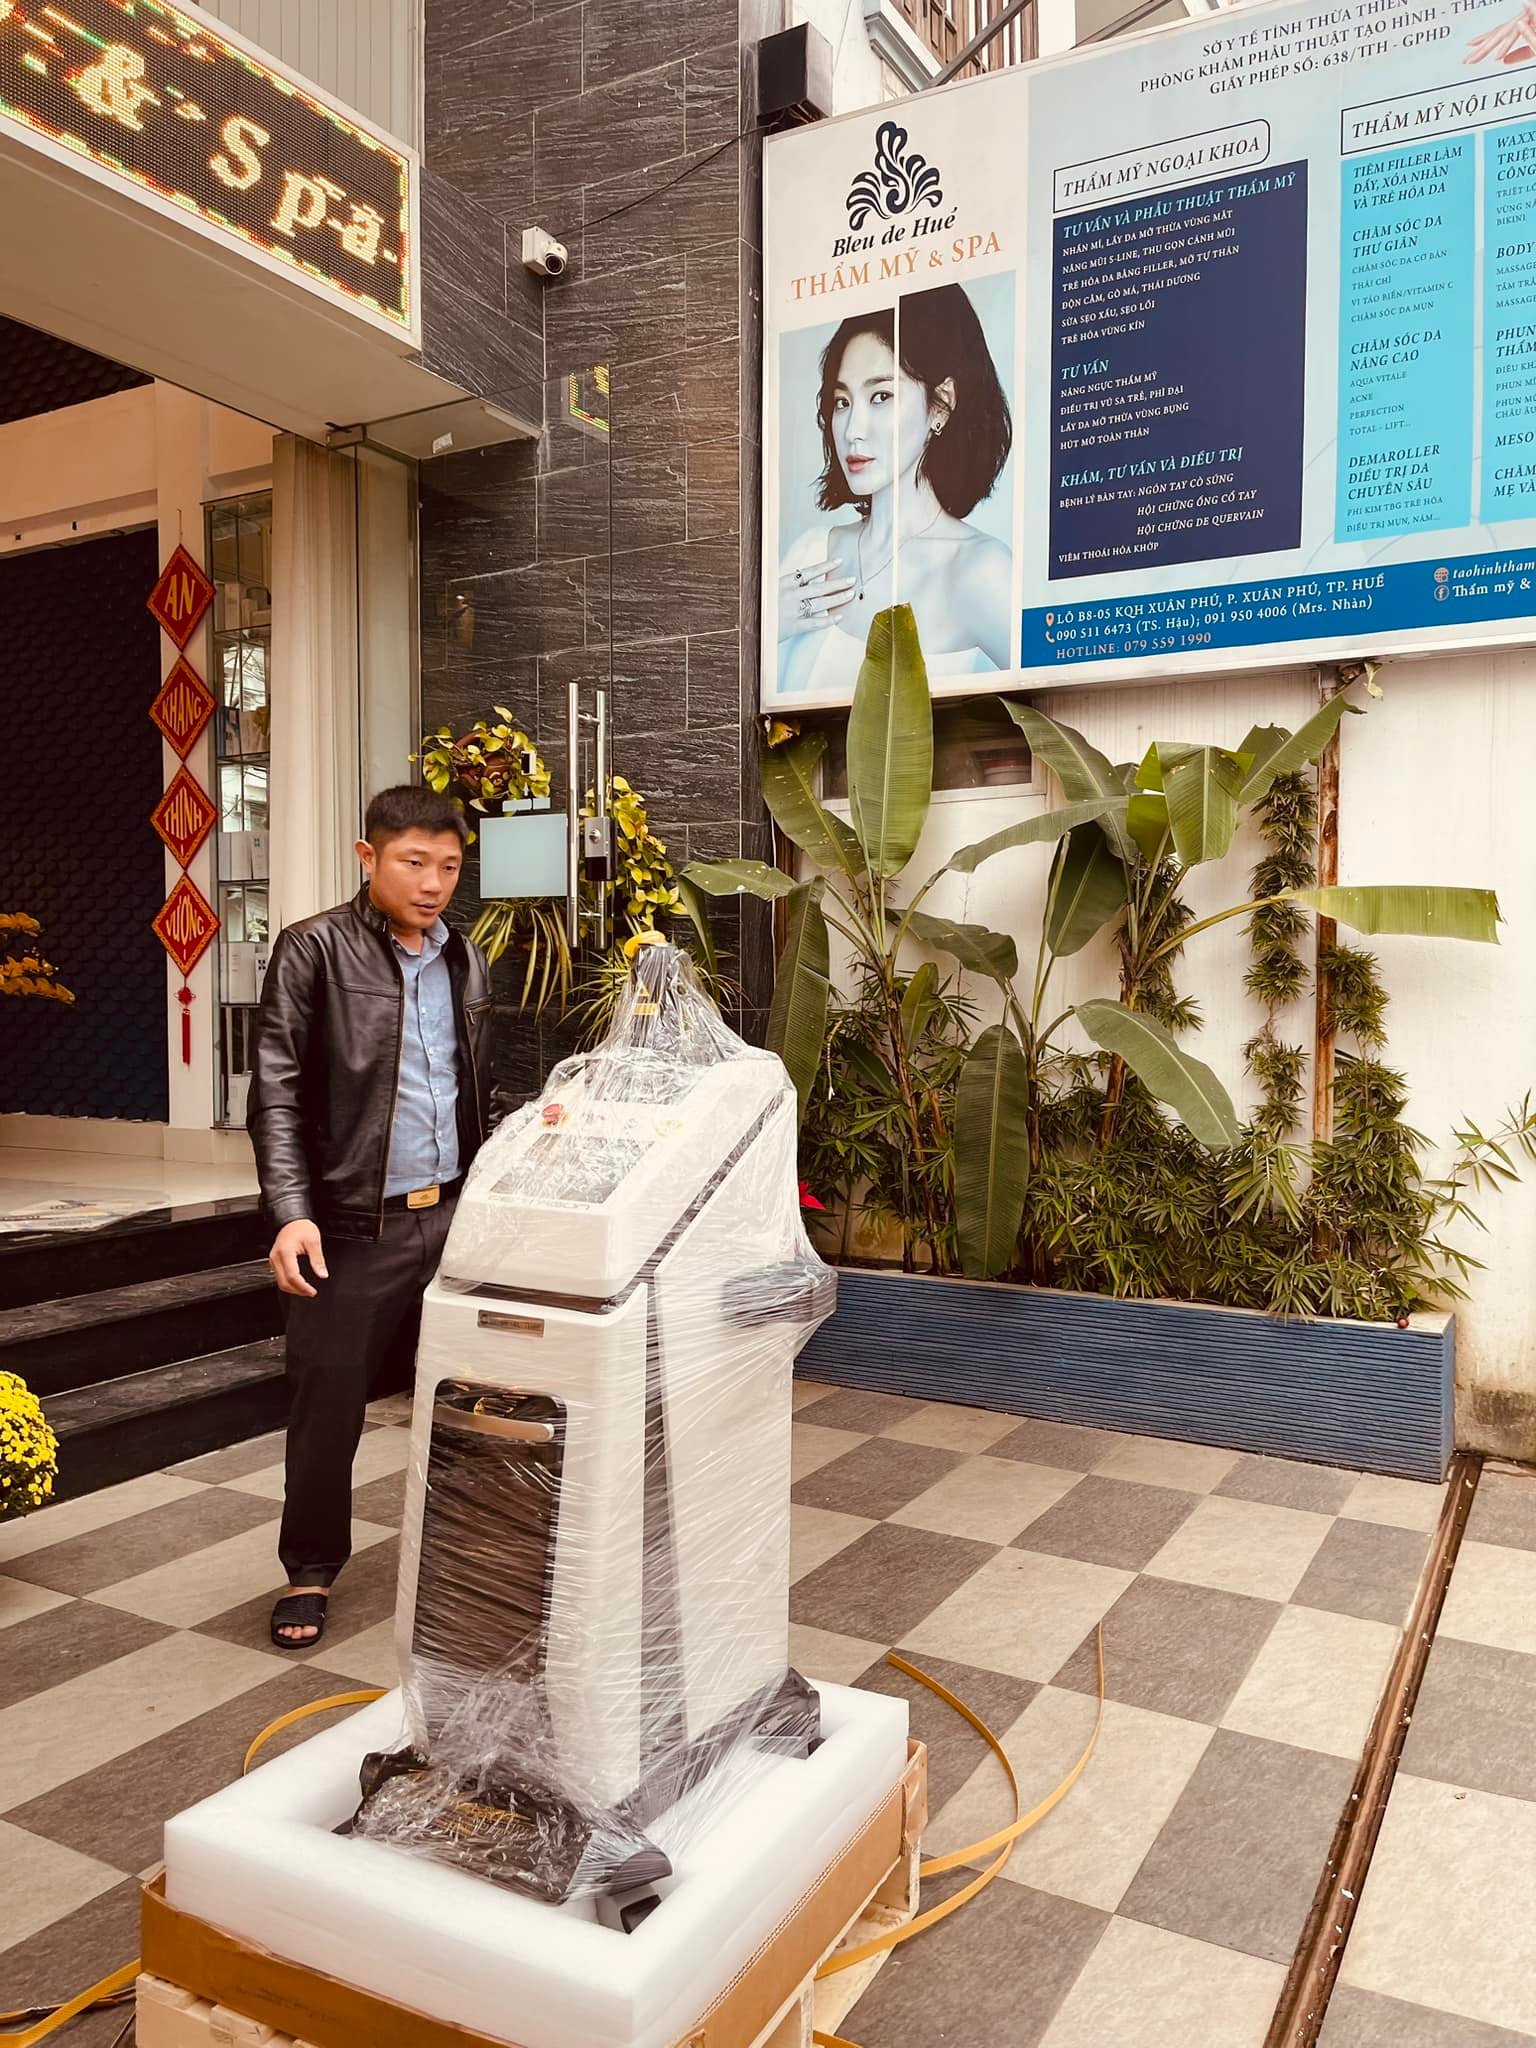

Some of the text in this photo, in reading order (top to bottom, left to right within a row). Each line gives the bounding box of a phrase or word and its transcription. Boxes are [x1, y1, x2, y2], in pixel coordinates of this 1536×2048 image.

[1227, 38, 1236, 50] Y
[1307, 4, 1351, 30] THỪA
[1140, 69, 1194, 92] PHÒNG
[1200, 54, 1244, 78] KHÁM
[1295, 30, 1350, 53] THUẬT
[1354, 20, 1386, 40] TẠO
[1392, 8, 1436, 29] HÌNH
[1250, 64, 1288, 86] PHÉP
[1324, 40, 1388, 68] 638/TTH
[1414, 105, 1444, 126] MỸ
[1449, 94, 1488, 118] NỘI
[1146, 148, 1203, 178] NGOẠI
[1209, 136, 1260, 162] KHOA
[1387, 151, 1431, 172] FILLER
[1354, 194, 1368, 210] VÀ
[1428, 182, 1446, 195] DA
[1063, 222, 1082, 238] TƯ
[1115, 210, 1130, 227] VÀ
[1176, 190, 1223, 212] THUẬT
[1394, 218, 1421, 234] SÓC
[1424, 216, 1442, 228] DA
[832, 235, 875, 258] Bleu
[882, 226, 905, 245] de
[1124, 231, 1137, 242] DA
[1143, 246, 1162, 257] THU
[1164, 240, 1184, 254] GỌN
[1496, 242, 1536, 259] BODY
[791, 232, 1002, 300] THẨM MỸ & SPA
[1394, 332, 1420, 348] SÓC
[1424, 329, 1441, 342] DA
[1392, 349, 1419, 364] CAO
[1061, 364, 1080, 380] TƯ
[1350, 378, 1374, 388] AQUA
[1350, 393, 1373, 404] ACNE
[1350, 404, 1404, 420] PERFECTION
[1495, 432, 1534, 447] MESO
[1348, 444, 1440, 468] DEMAROLLER
[1060, 471, 1104, 488] KHÁM,
[1108, 463, 1128, 479] TƯ
[1160, 456, 1176, 472] VÀ
[1219, 447, 1243, 462] TRỊ
[1385, 465, 1407, 479] TRỊ
[1411, 462, 1429, 475] DA
[1117, 488, 1136, 500] TAY:
[1170, 480, 1188, 492] TAY
[1238, 490, 1258, 501] TAY
[1196, 516, 1210, 528] DE
[1212, 508, 1264, 526] QUERVAIN
[1520, 578, 1531, 590] &
[164, 571, 196, 622] AN
[1057, 611, 1074, 625] LÔ
[1078, 608, 1111, 622] B8-05
[1115, 604, 1144, 620] KQH
[1148, 598, 1186, 614] XUÂN
[1190, 593, 1224, 610] PHÚ,
[1228, 594, 1238, 604] P.
[1242, 586, 1282, 603] XUÂN
[1287, 581, 1322, 598] PHÚ,
[1326, 581, 1348, 594] TP.
[1056, 628, 1077, 641] 090
[1080, 626, 1100, 638] 511
[1104, 622, 1132, 636] 6473
[1136, 618, 1162, 636] (TS.
[1204, 612, 1227, 625] 091
[1230, 609, 1253, 622] 950
[1257, 604, 1288, 620] 4006
[1292, 601, 1326, 618] (Mrs.
[1056, 632, 1211, 660] HOTLINE: 079 559 1990
[162, 682, 201, 737] KHANG
